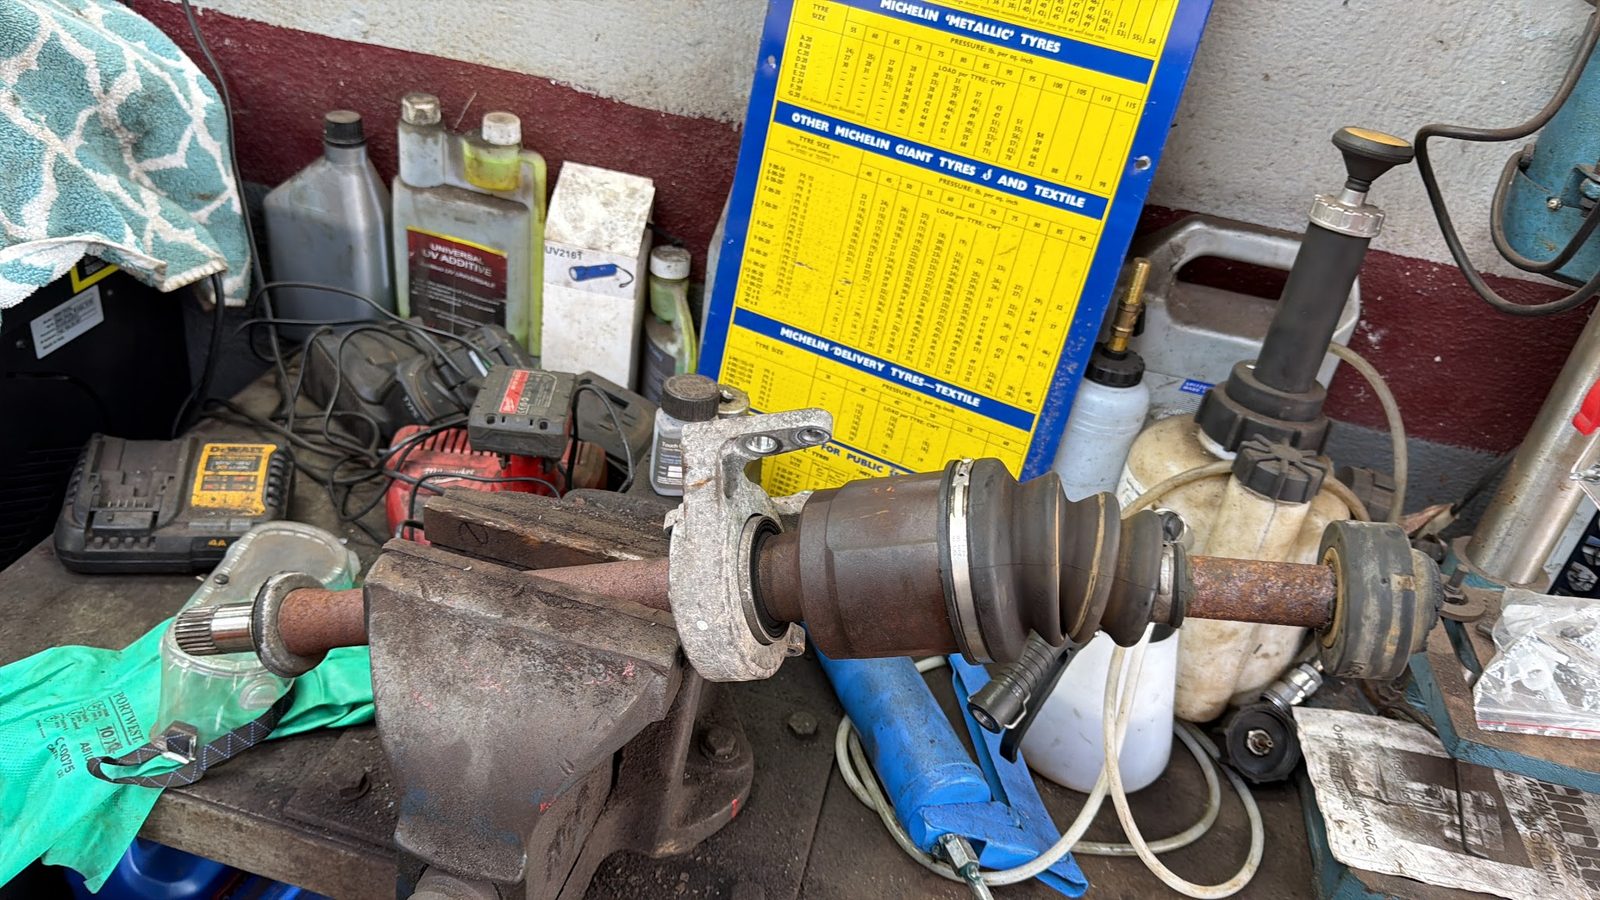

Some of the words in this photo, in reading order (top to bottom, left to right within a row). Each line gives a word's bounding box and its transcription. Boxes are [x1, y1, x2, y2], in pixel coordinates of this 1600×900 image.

[812, 12, 825, 21] SIZE
[813, 3, 829, 13] TYRE
[880, 0, 939, 21] MICHELIN
[1021, 33, 1060, 52] TYRES
[950, 37, 986, 51] PRESSURE:
[938, 65, 956, 74] LOAD
[792, 113, 829, 132] OTHER
[835, 126, 890, 150] MICHELIN
[895, 144, 933, 163] GIANT
[939, 157, 975, 175] TYRES
[997, 175, 1027, 190] AND
[1035, 185, 1085, 208] TEXTILE
[422, 249, 439, 260] UV
[440, 254, 492, 277] ADDITIVE
[430, 243, 484, 265] UNIVERSAL
[780, 327, 830, 352] MICHELIN
[821, 443, 841, 456] FOR
[847, 453, 884, 473] PUBLIC
[114, 691, 145, 743] PORTWEST
